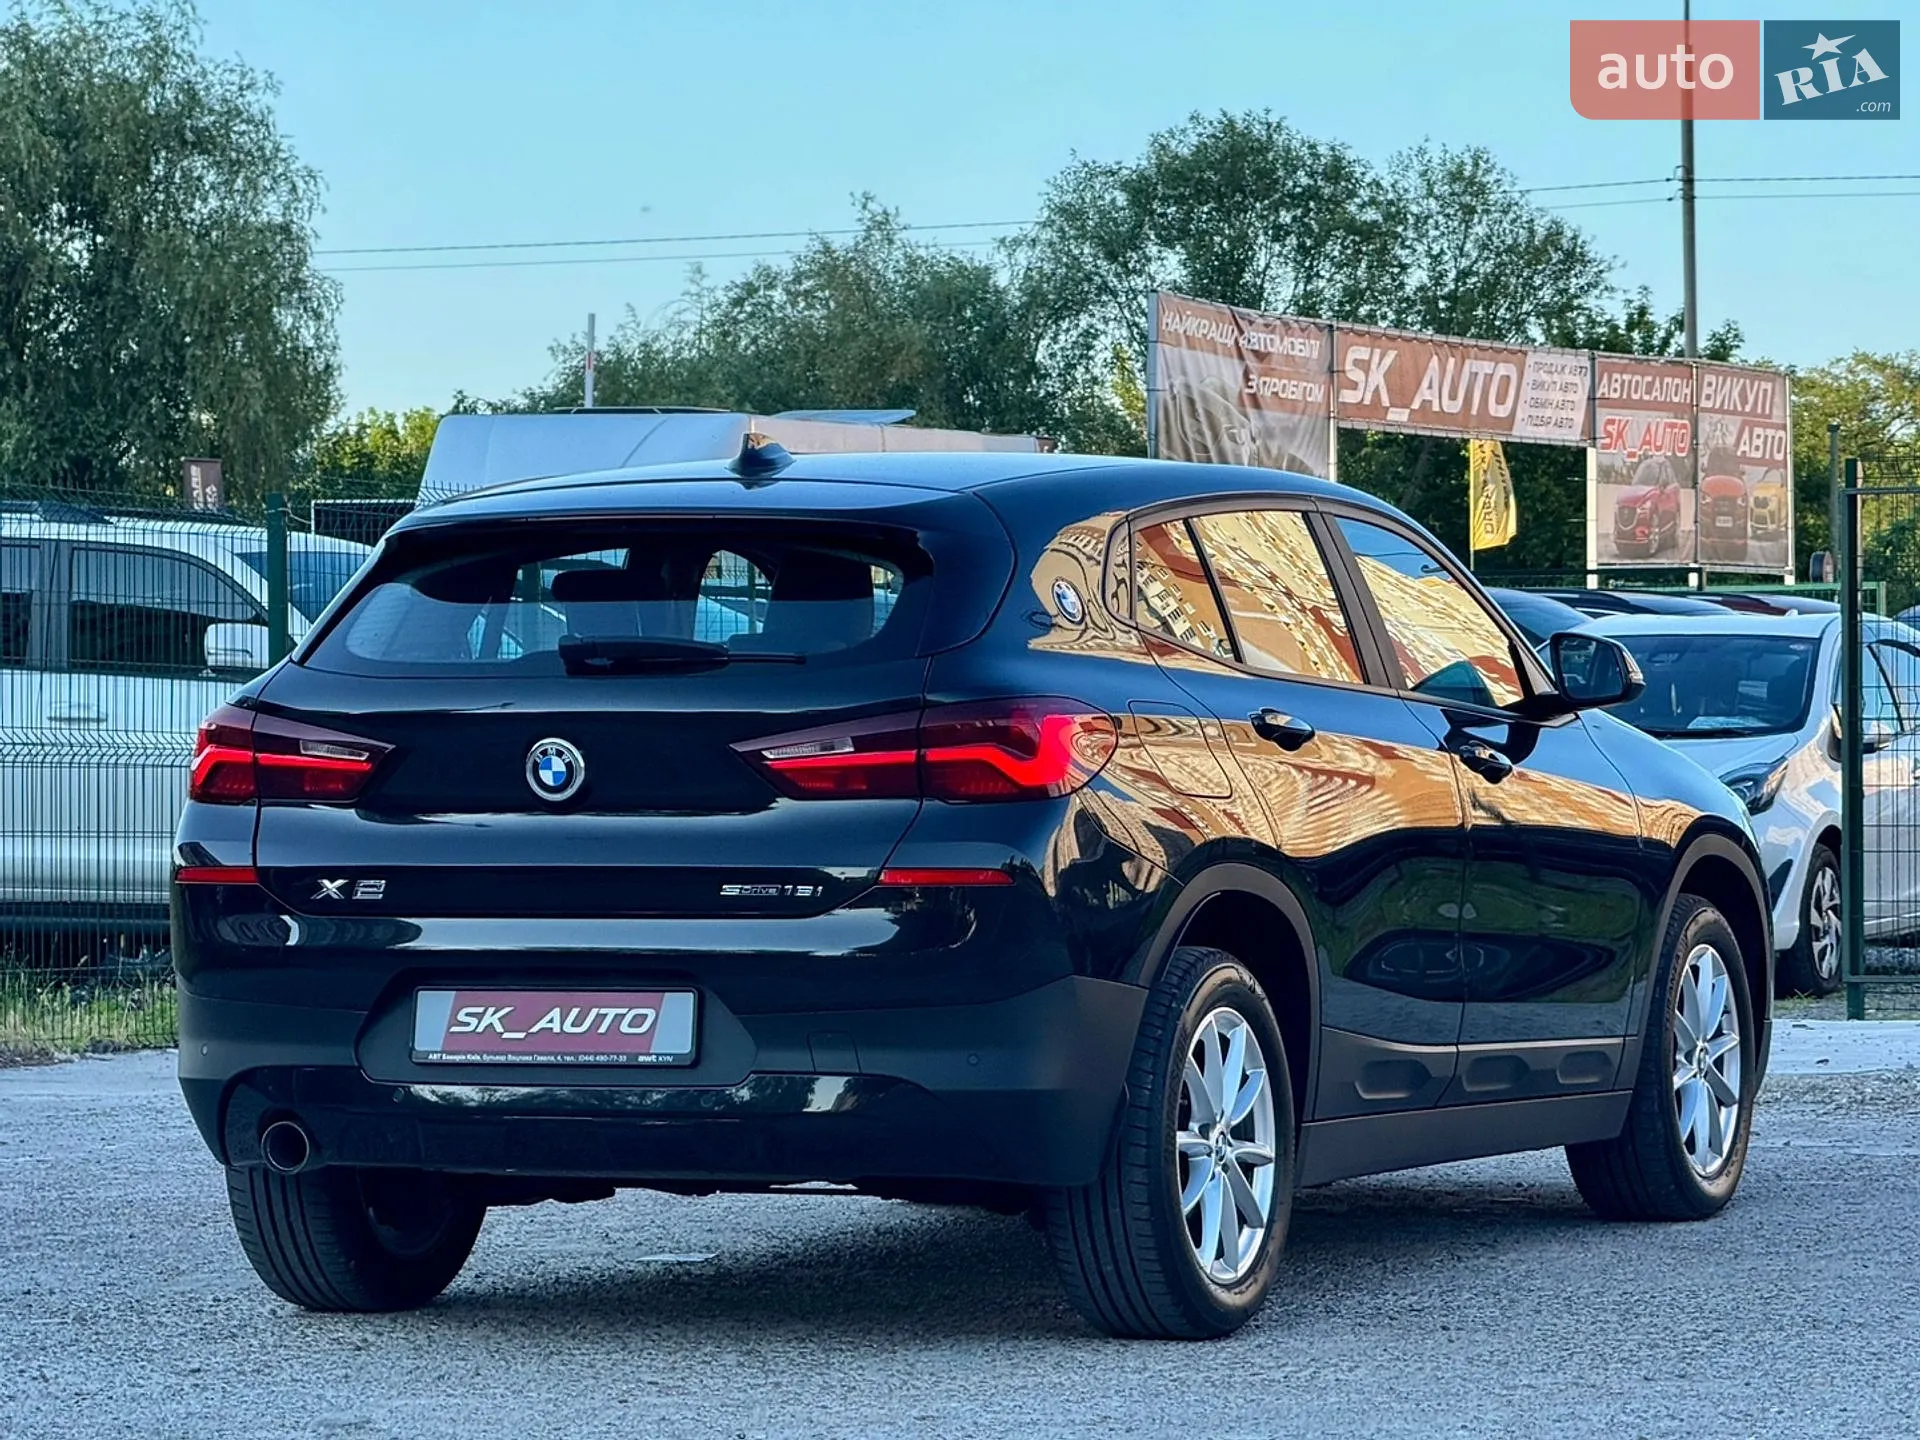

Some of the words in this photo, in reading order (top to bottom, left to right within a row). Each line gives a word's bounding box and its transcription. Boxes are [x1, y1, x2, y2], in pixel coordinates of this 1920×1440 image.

[1340, 345, 1518, 422] SK_AUTO
[1597, 371, 1693, 404] АВТОСАЛОН
[1701, 373, 1773, 415] ВИКУП
[1600, 415, 1692, 462] SK_AUTO
[1736, 425, 1787, 462] АВТО
[309, 879, 386, 900] X2
[449, 1006, 657, 1039] SK_AUTO
